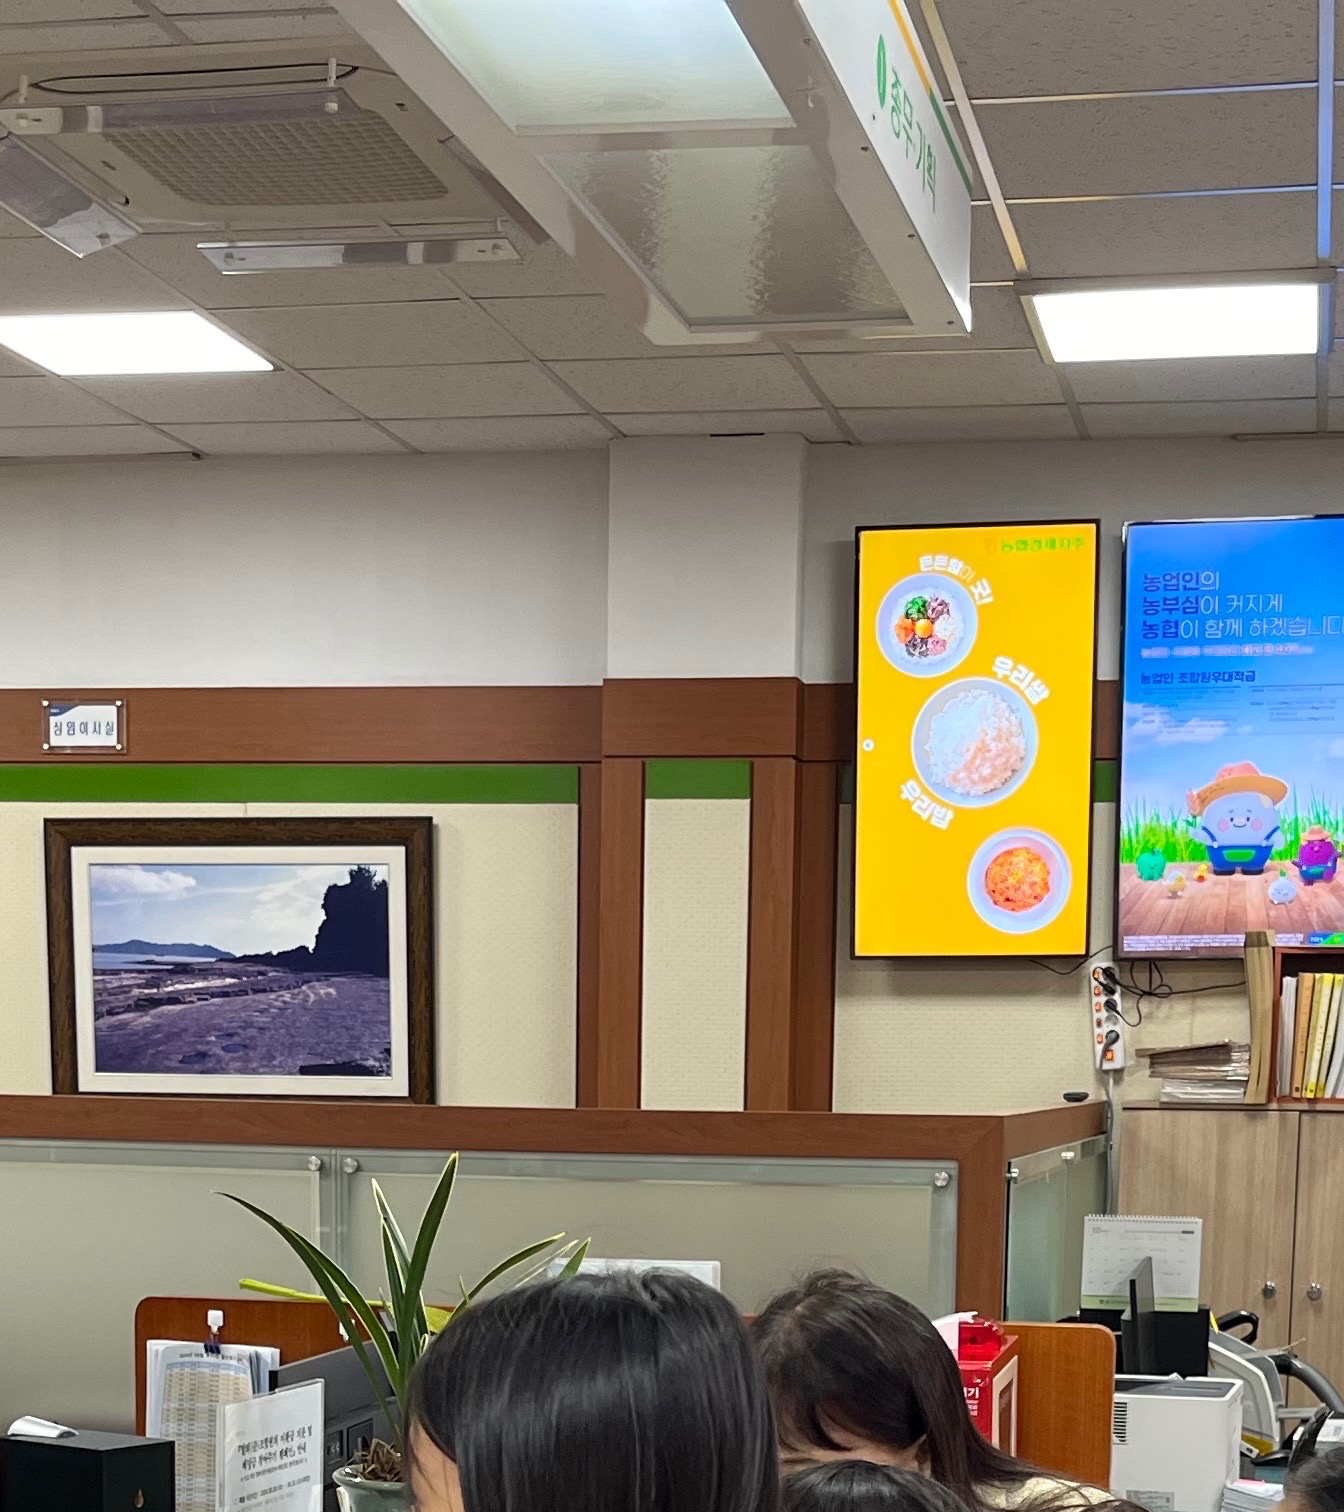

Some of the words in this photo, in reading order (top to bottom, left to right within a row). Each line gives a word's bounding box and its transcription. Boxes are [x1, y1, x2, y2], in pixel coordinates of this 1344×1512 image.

[1143, 571, 1219, 592] 농업인의
[1142, 595, 1218, 616] 농부심이
[1225, 593, 1283, 613] 커지게
[1142, 619, 1199, 639] 농협이
[1204, 618, 1243, 639] 함께
